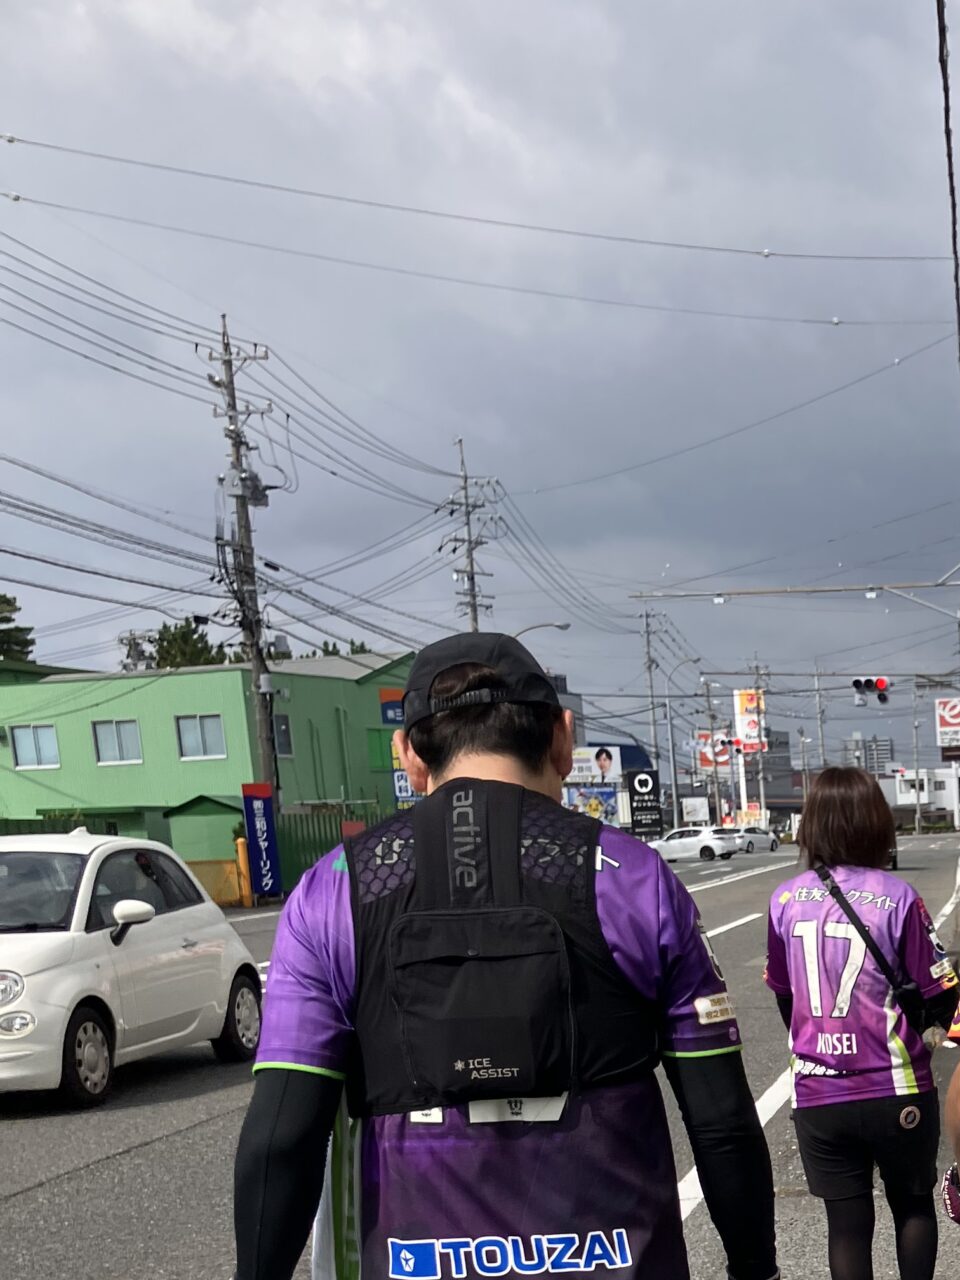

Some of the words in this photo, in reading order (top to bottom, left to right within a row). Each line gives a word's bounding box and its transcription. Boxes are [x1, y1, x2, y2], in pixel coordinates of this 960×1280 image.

[453, 789, 482, 888] active
[795, 887, 897, 910] 住友クライト
[792, 919, 869, 1018] 17
[816, 1032, 858, 1056] KOSEI
[468, 1058, 492, 1069] ICE
[471, 1067, 520, 1080] ASSIST
[438, 1229, 633, 1278] TOUZAI
